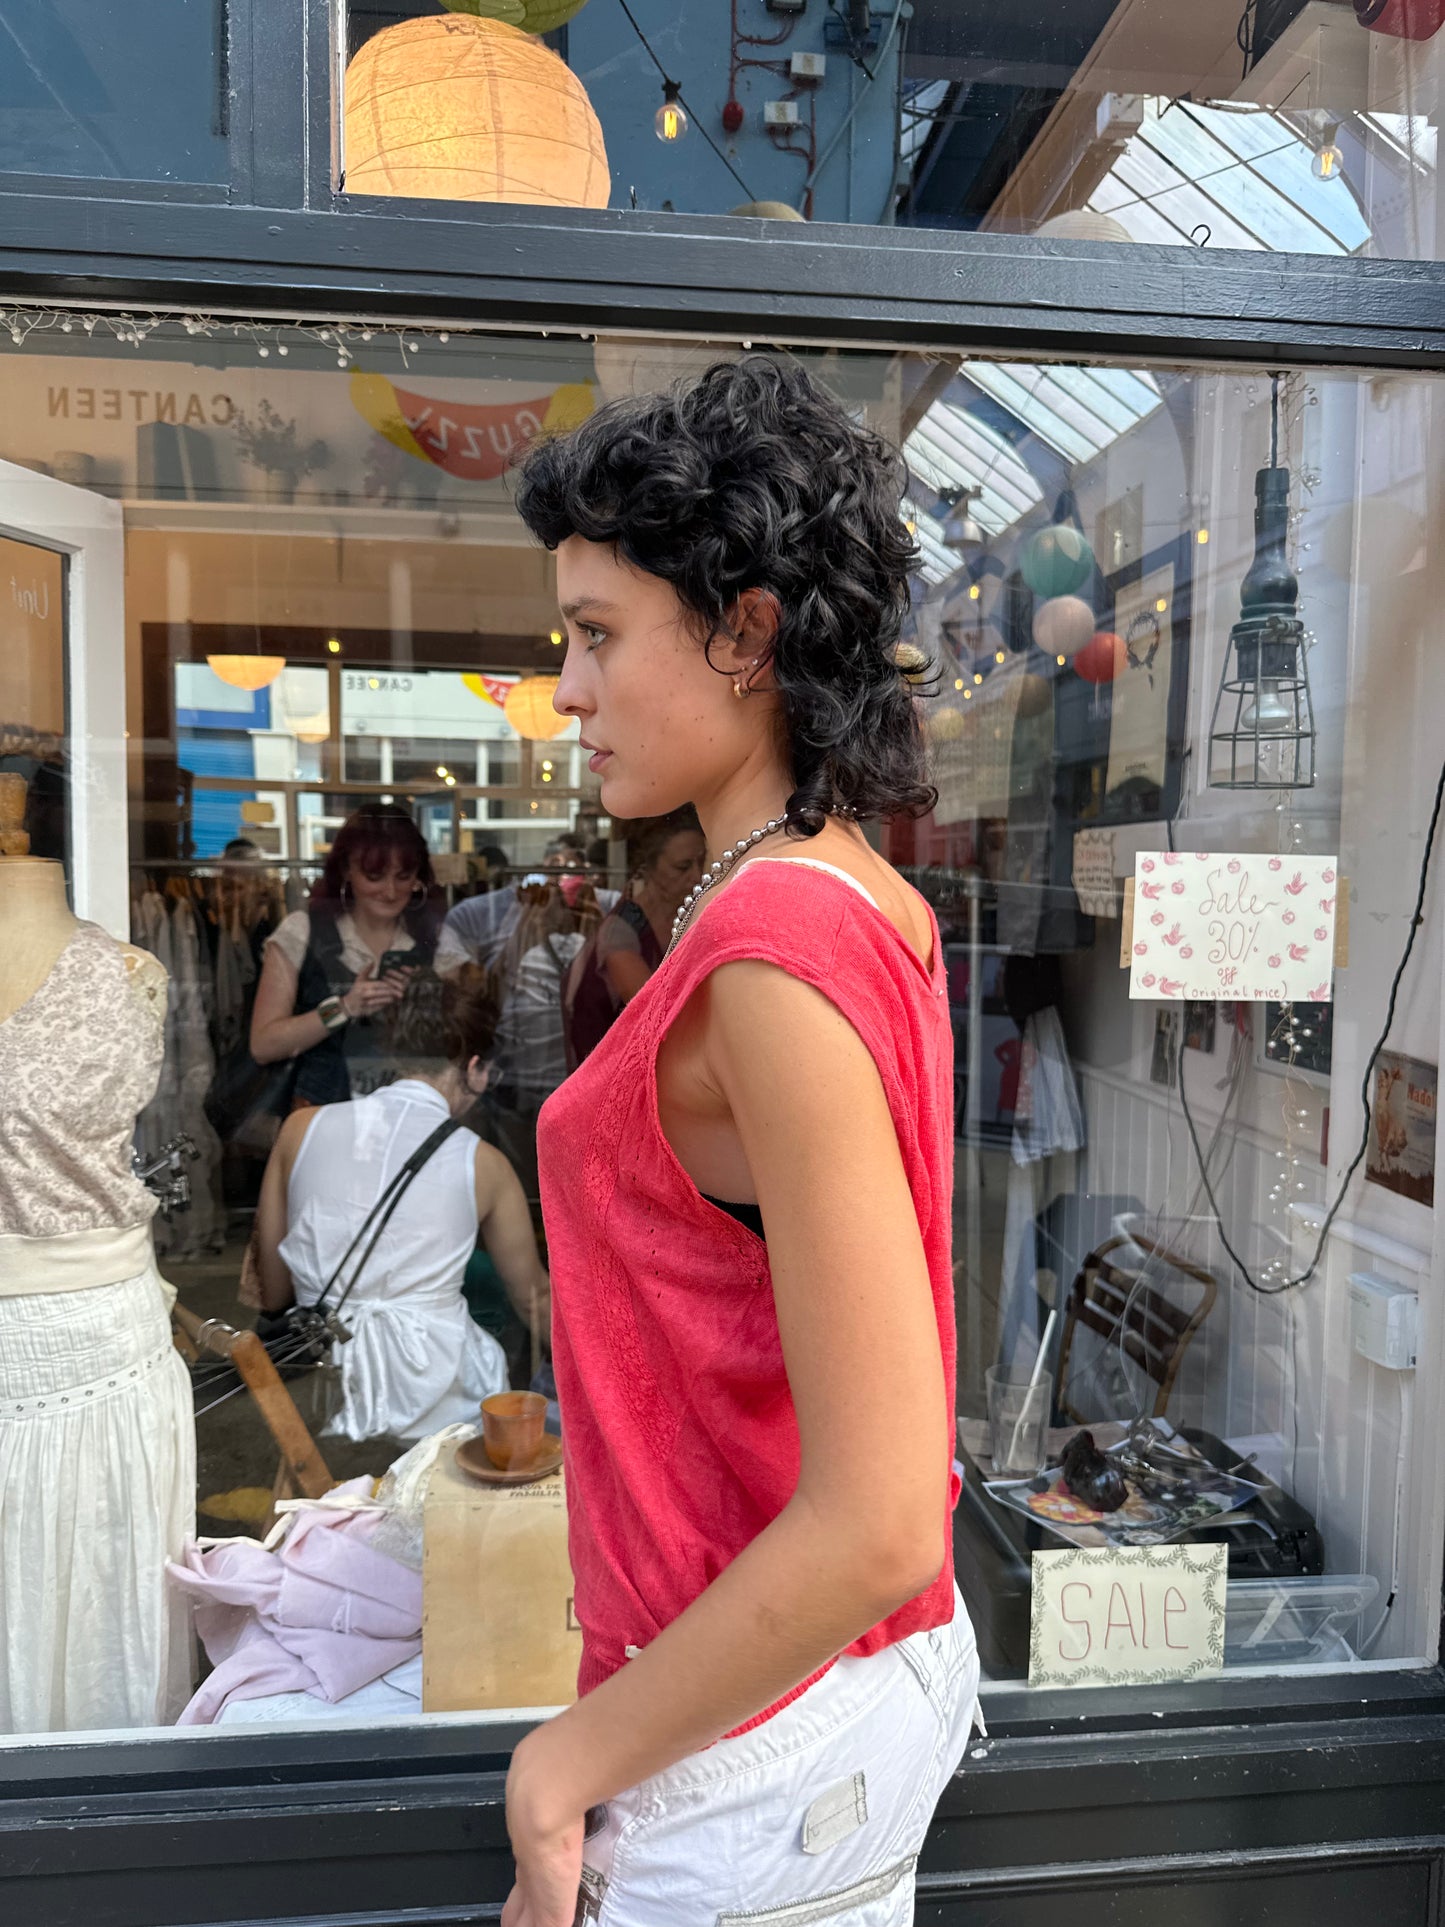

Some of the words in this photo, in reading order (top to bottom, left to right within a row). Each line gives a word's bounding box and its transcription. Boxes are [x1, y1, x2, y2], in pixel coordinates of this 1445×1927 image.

[1199, 868, 1280, 916] Sale
[1207, 919, 1260, 964] 30%
[1217, 966, 1238, 987] off
